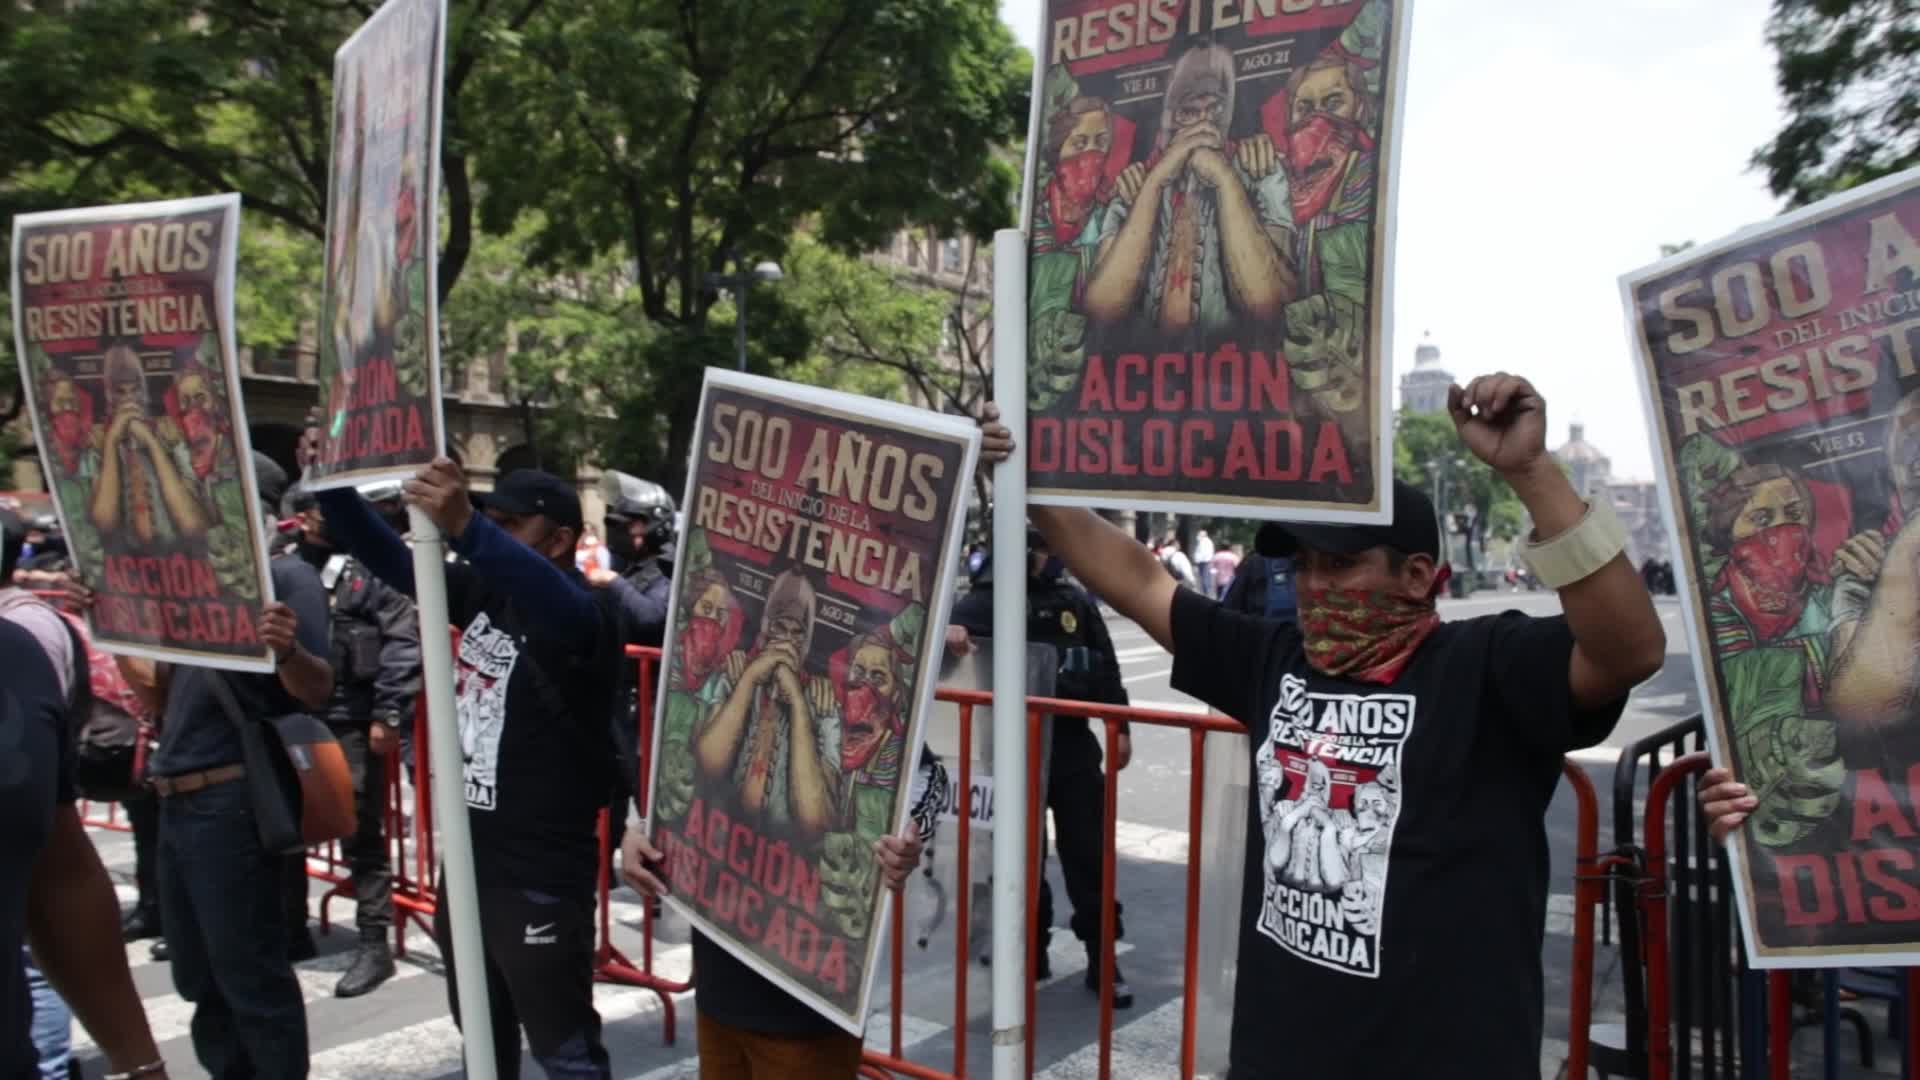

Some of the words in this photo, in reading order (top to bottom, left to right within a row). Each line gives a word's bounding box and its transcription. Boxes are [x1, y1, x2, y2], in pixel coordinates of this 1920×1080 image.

[1241, 52, 1272, 71] AGO
[1274, 51, 1291, 64] 21
[23, 231, 93, 285] 500
[103, 221, 213, 278] AÑOS
[27, 294, 212, 343] RESISTENCIA
[1659, 239, 1832, 355] 500
[1775, 319, 1832, 350] DEL
[1078, 341, 1289, 412] ACCIÓN
[707, 402, 792, 480] 500
[796, 426, 945, 522] AÑOS
[1029, 417, 1353, 484] DISLOCADA
[752, 479, 776, 502] DEL
[105, 551, 218, 599] ACCIÓN
[696, 485, 923, 602] RESISTENCIA
[683, 797, 822, 913] ACCIÓN
